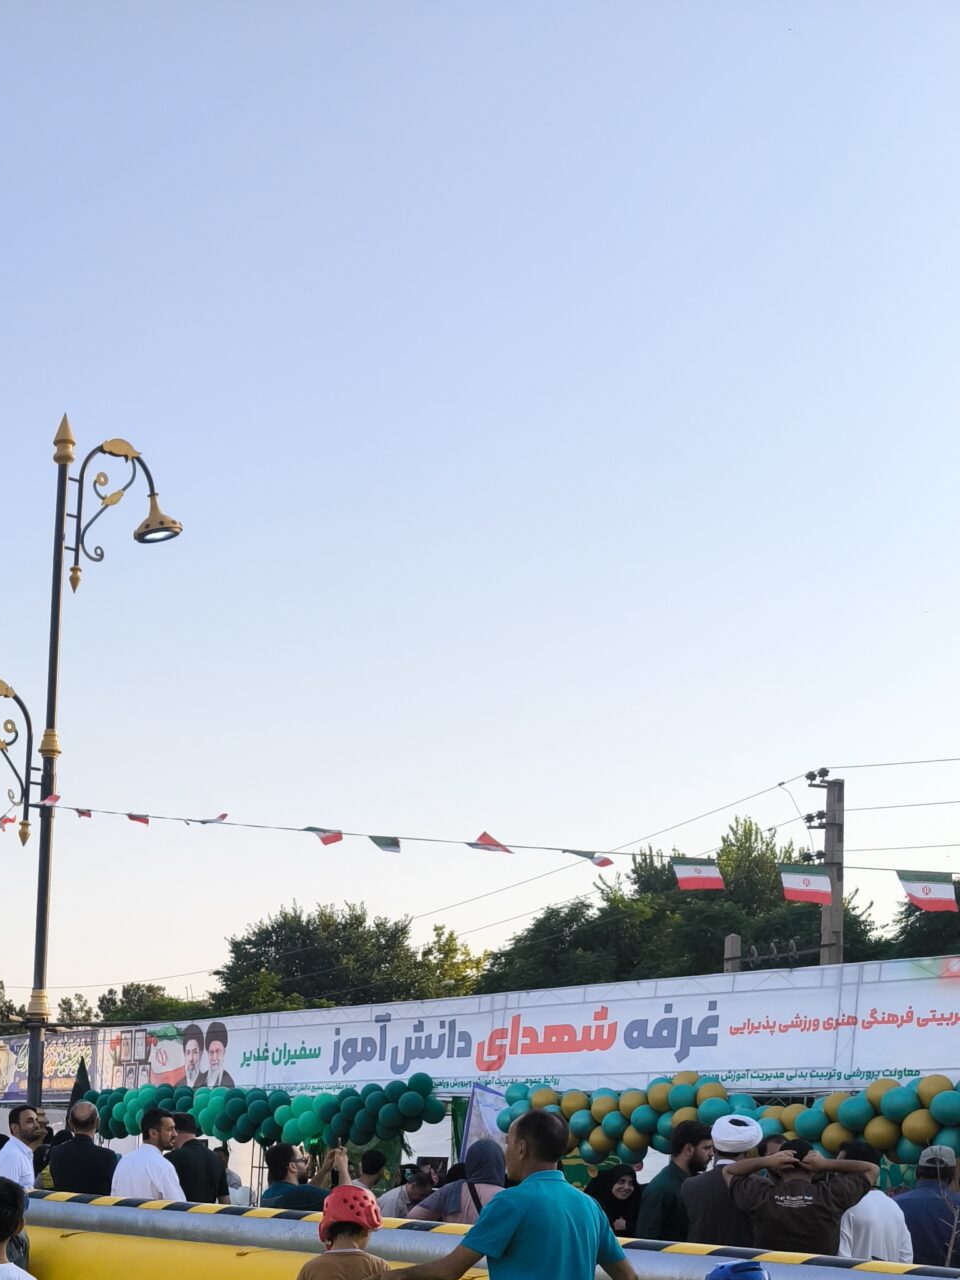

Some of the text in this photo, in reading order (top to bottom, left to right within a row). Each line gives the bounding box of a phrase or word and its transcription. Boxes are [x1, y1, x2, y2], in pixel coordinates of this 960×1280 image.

[729, 1006, 960, 1036] ربیتی فرهنگی هنری ورزشی پذیرایی
[329, 1000, 720, 1076] غرفه شهدای دانش آموز
[240, 1040, 322, 1068] سفیران غدیر
[720, 1069, 750, 1082] آموزش
[750, 1070, 784, 1082] مدیریت
[786, 1069, 808, 1082] بدنی
[882, 1067, 921, 1080] معاونت
